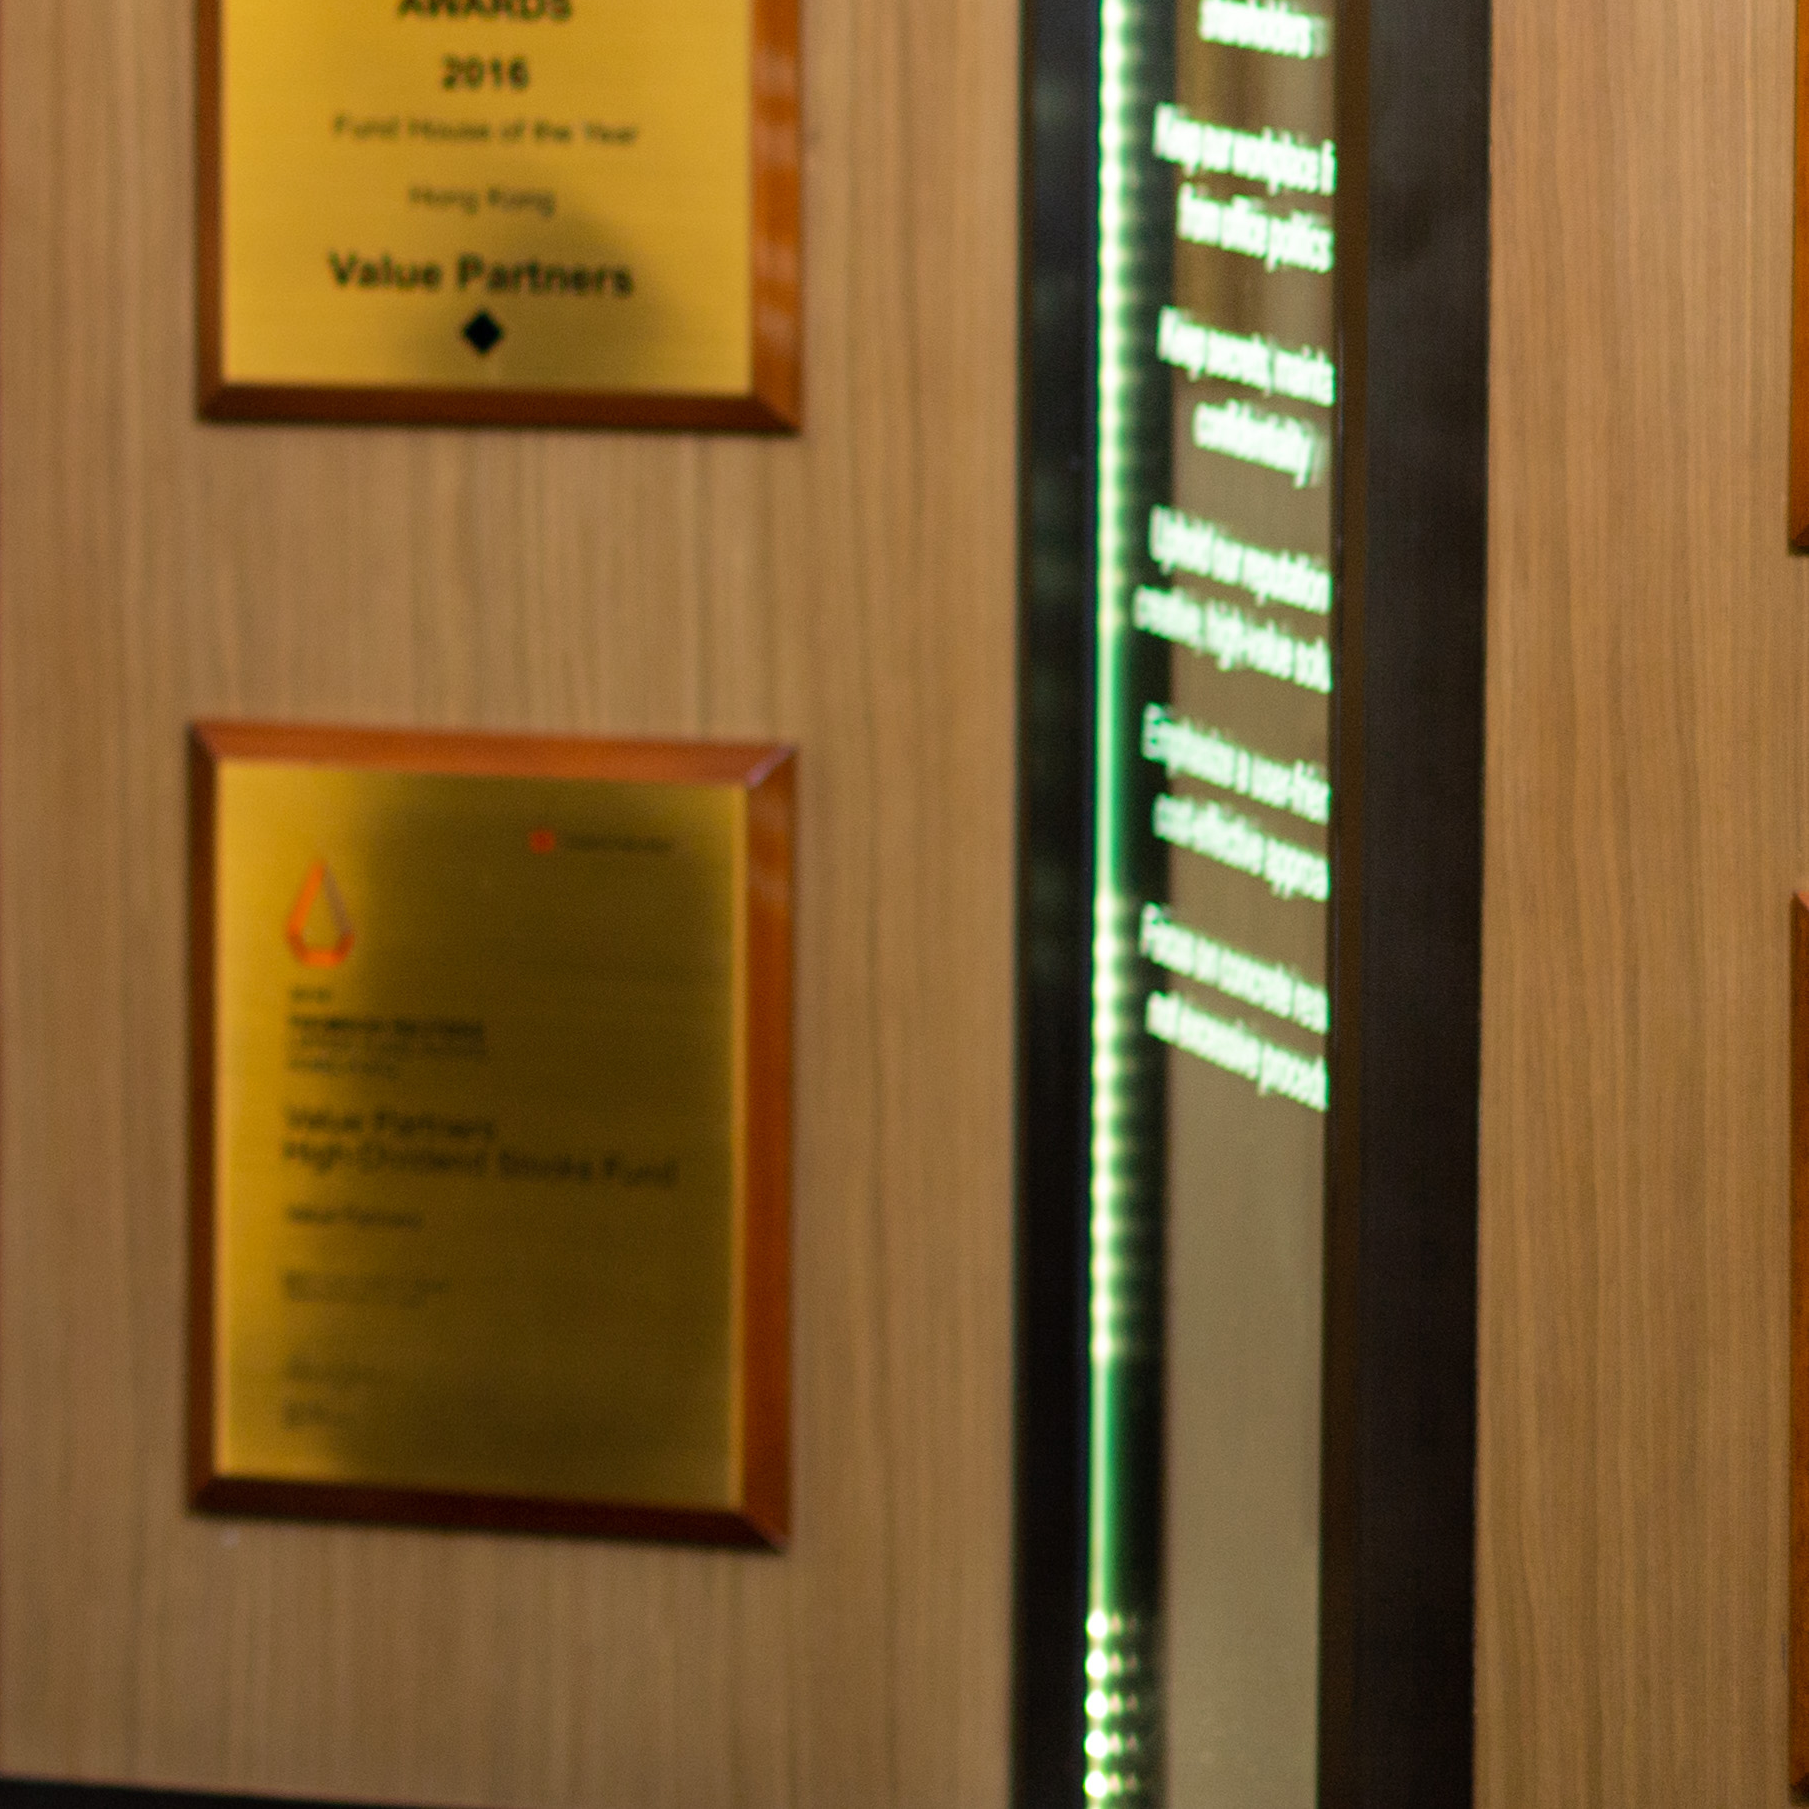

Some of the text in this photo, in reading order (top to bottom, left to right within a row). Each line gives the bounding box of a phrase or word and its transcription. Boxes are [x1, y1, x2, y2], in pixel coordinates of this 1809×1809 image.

[441, 57, 530, 90] 2016
[334, 115, 639, 148] Fund House of the Year
[409, 183, 557, 220] Hong Kong
[328, 252, 636, 297] Value Partners
